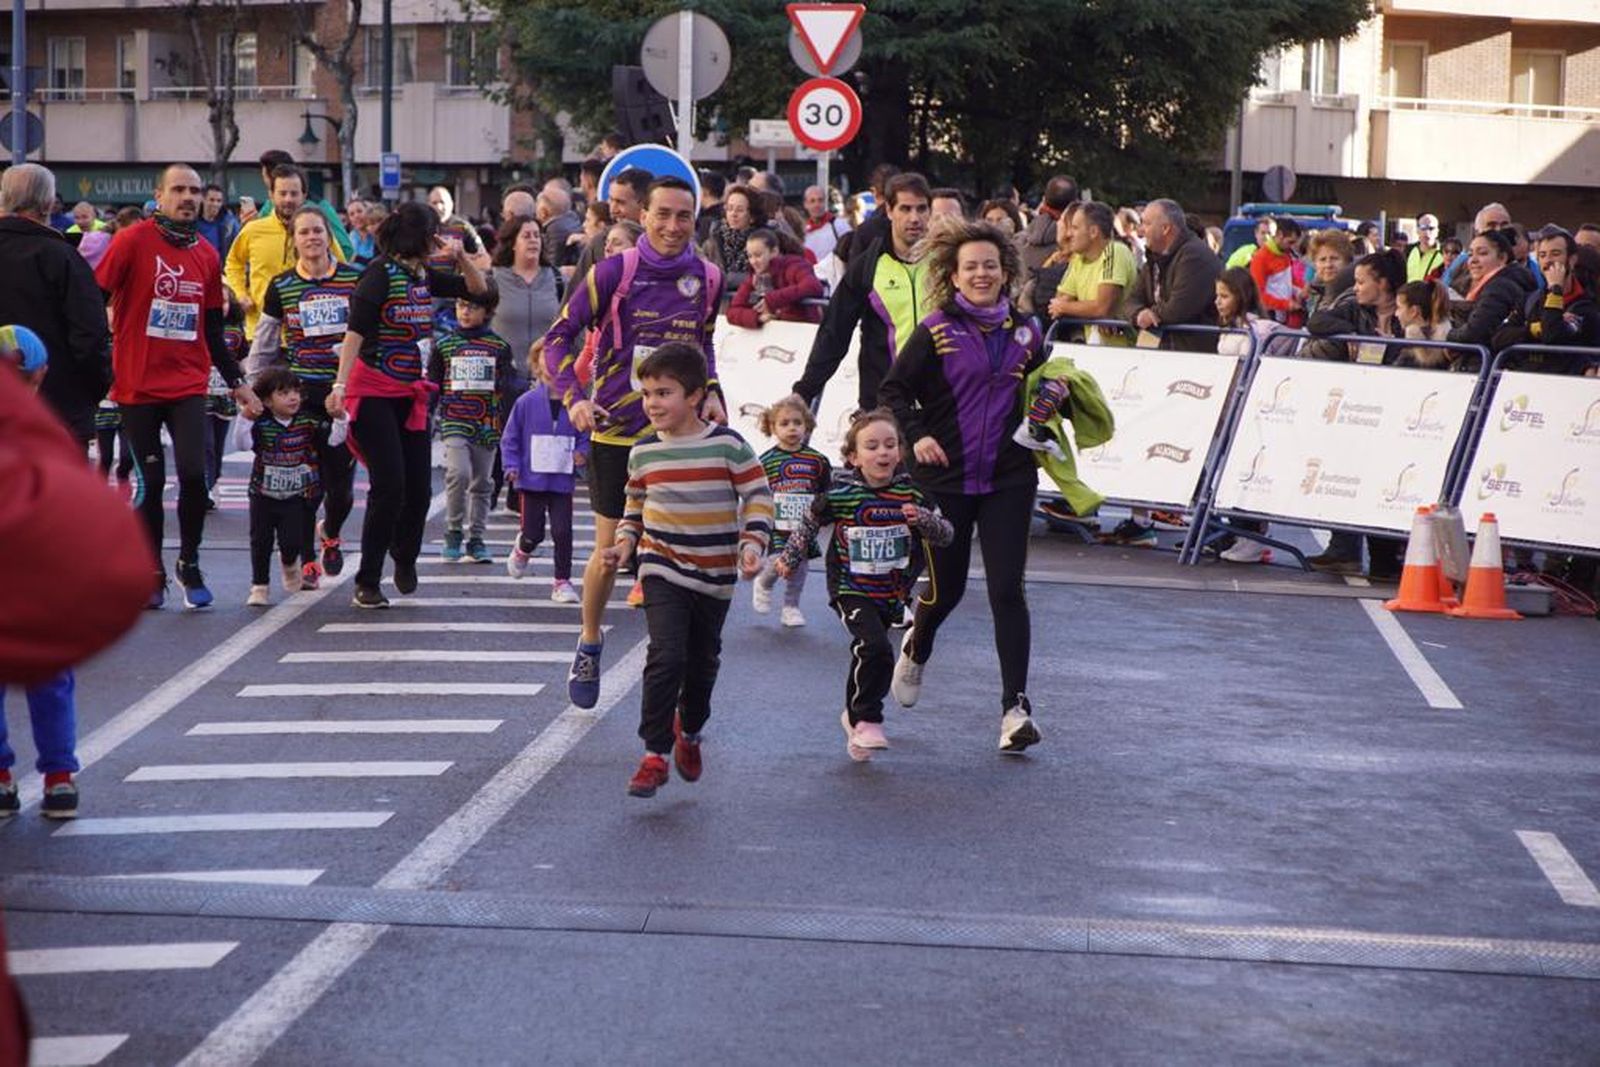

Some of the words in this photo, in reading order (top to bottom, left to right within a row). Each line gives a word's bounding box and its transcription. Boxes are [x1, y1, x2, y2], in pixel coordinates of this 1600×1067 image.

[805, 103, 843, 126] 30
[95, 176, 120, 197] CAJA
[121, 177, 152, 194] RURAL
[307, 308, 339, 325] 3425
[861, 539, 896, 559] 6178
